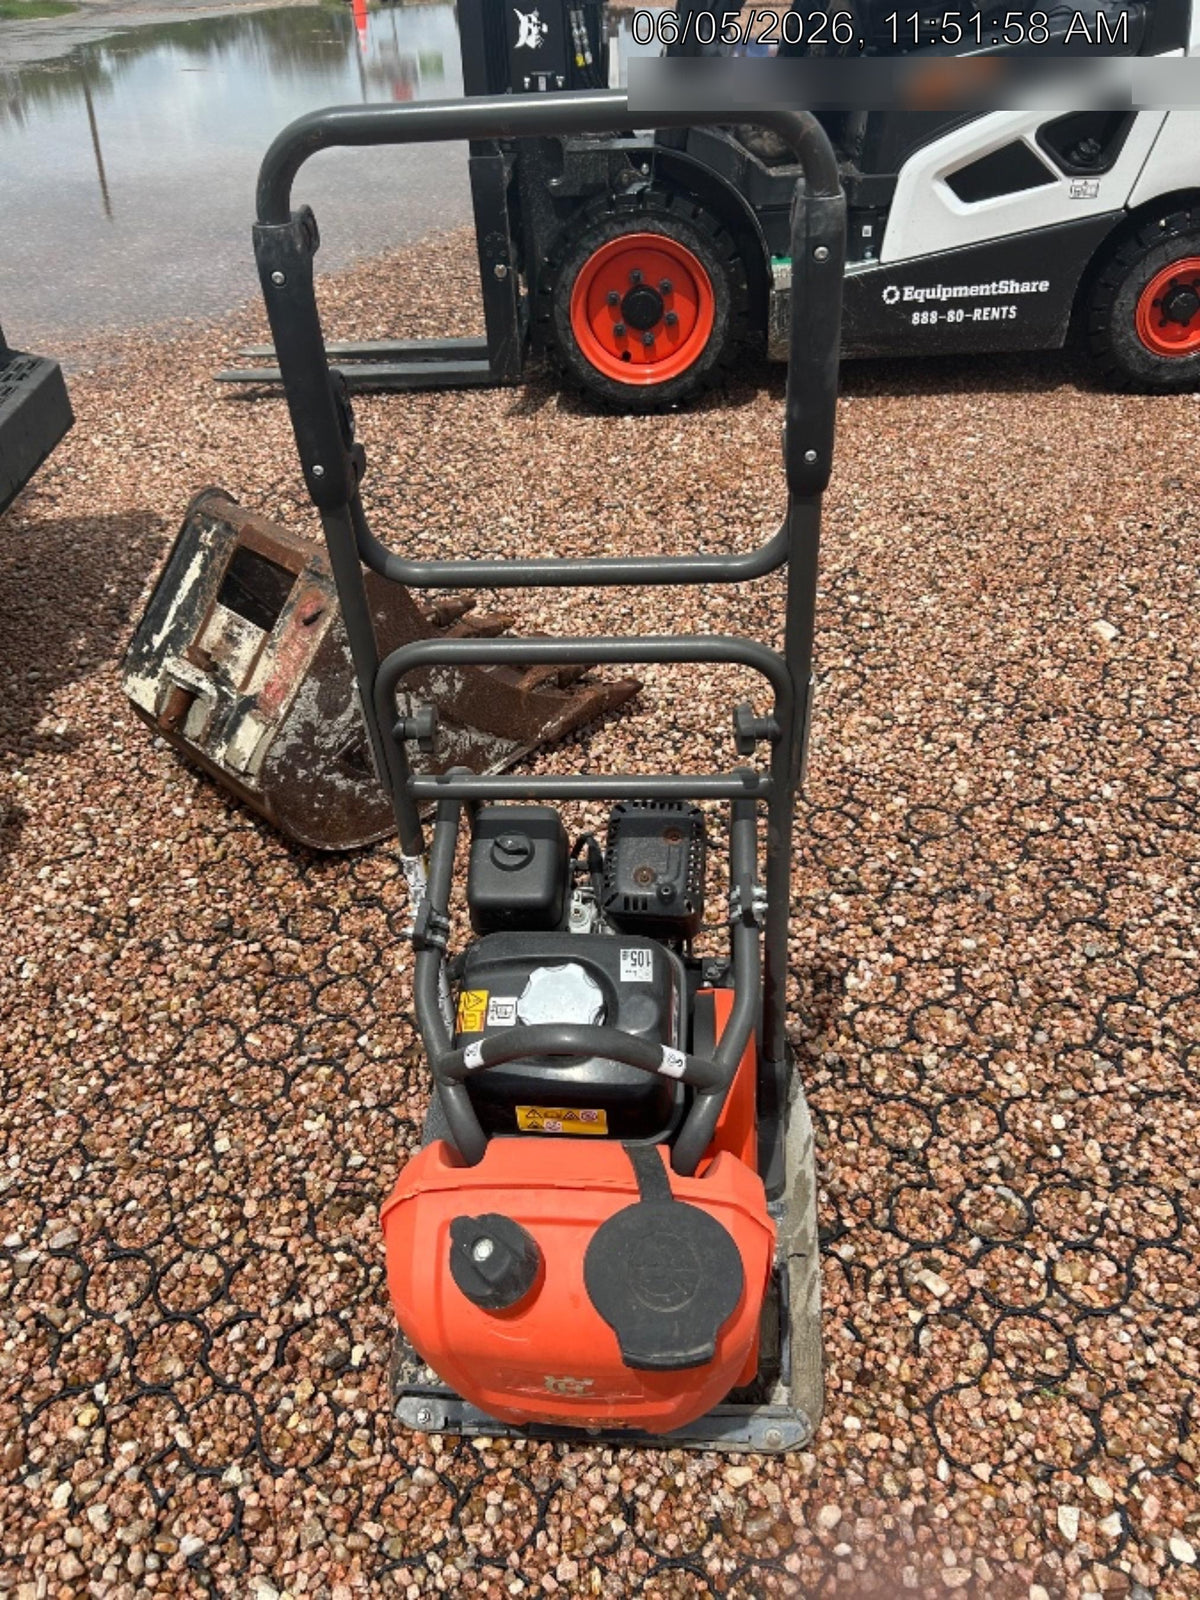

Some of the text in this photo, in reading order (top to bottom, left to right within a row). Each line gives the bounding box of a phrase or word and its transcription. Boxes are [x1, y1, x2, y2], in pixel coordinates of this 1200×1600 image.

[902, 279, 1050, 303] EquipmentShare
[911, 305, 1018, 326] 888-80-RENTS
[630, 951, 651, 968] 105
